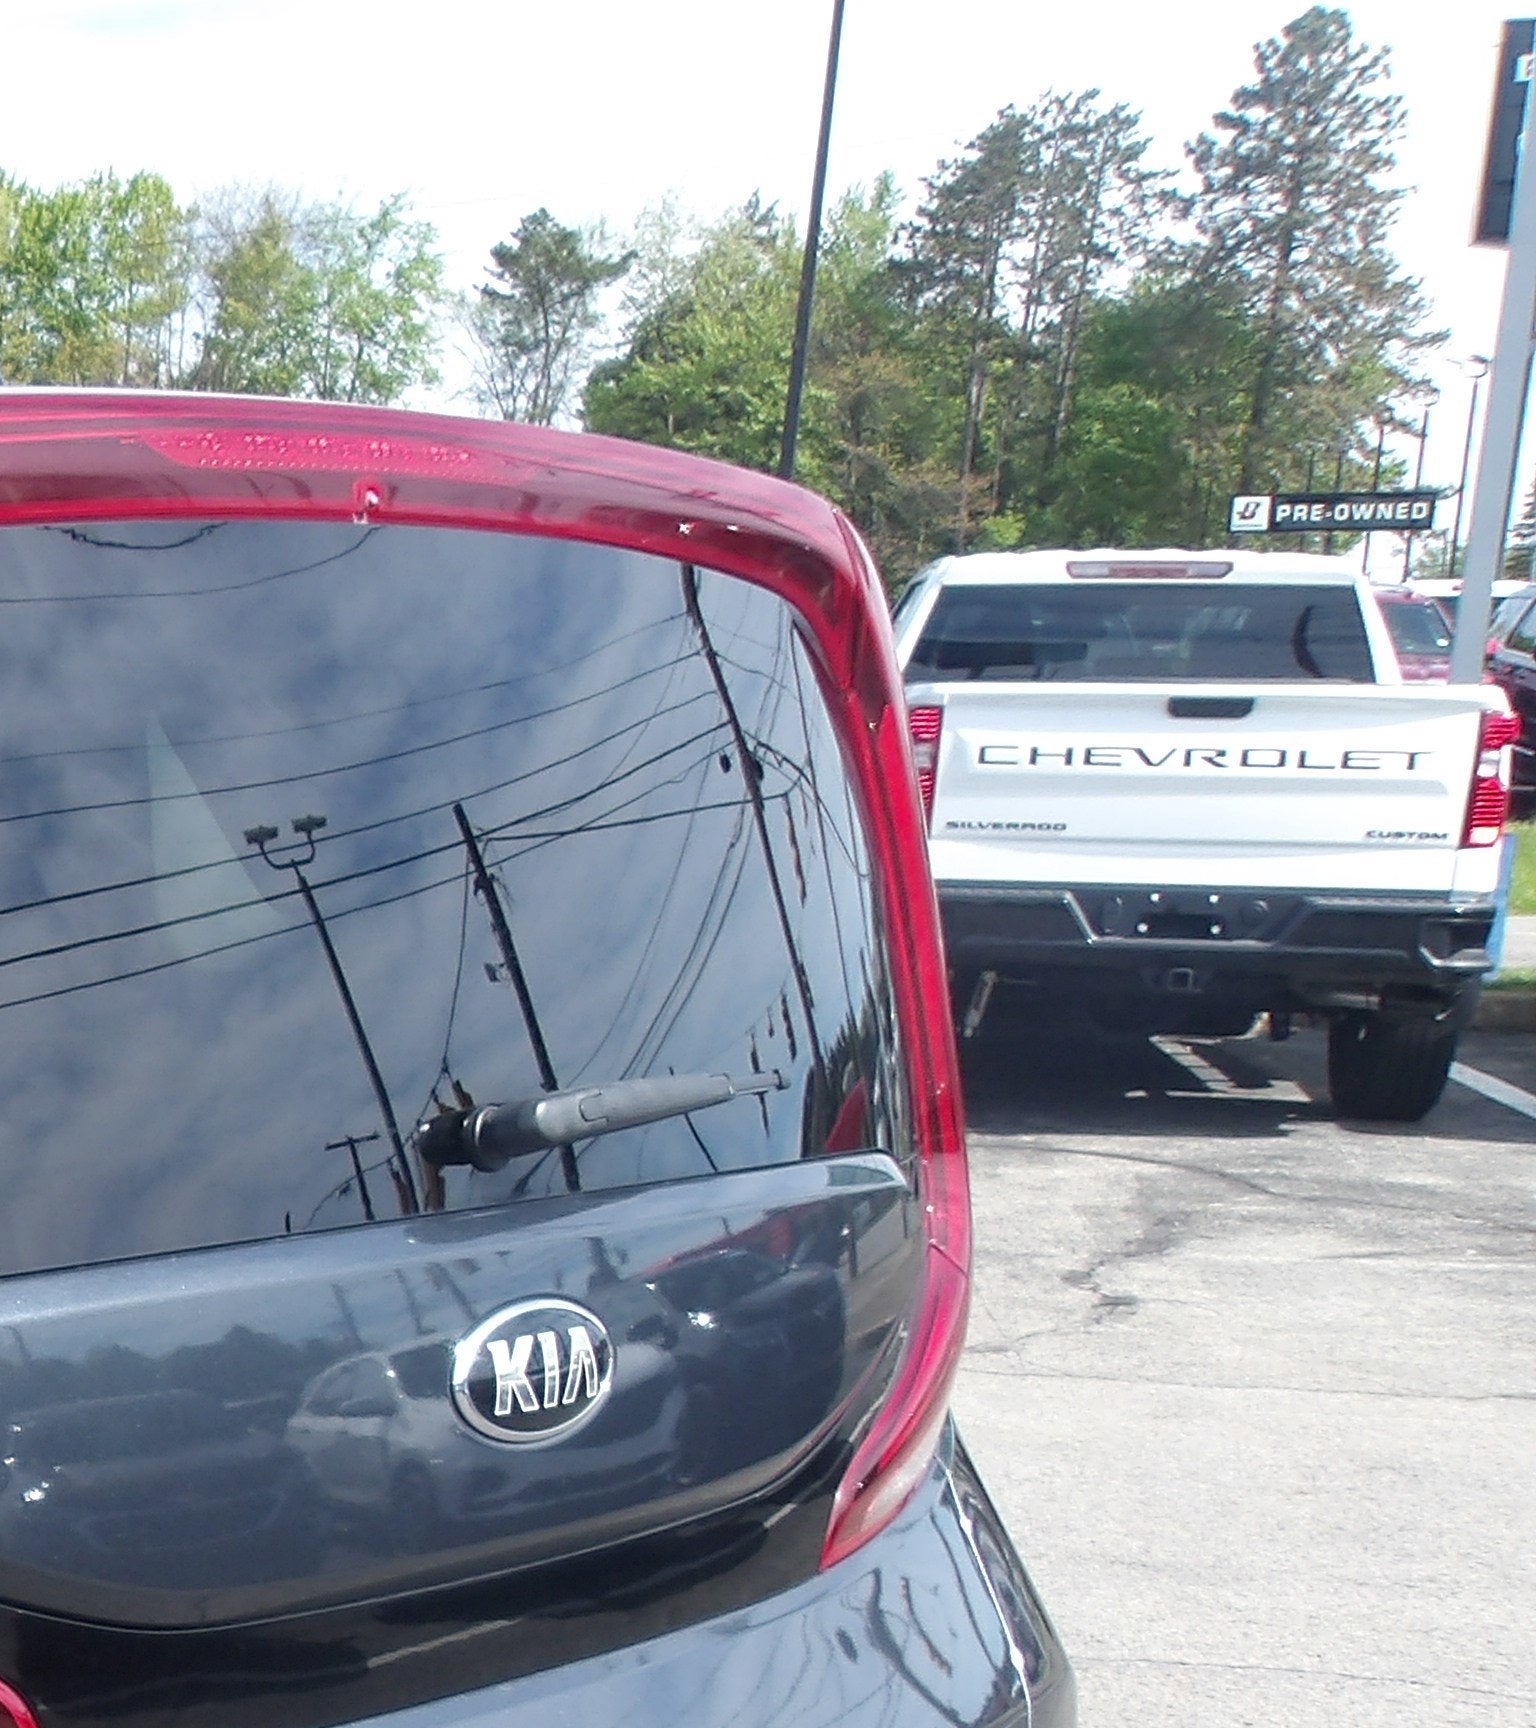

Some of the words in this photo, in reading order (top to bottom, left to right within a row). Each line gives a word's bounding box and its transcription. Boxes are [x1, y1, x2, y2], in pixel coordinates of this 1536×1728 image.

[1275, 502, 1428, 522] PRE-OWNED
[977, 745, 1436, 771] CHEVROLET
[944, 820, 1068, 832] SILVERADO
[1364, 829, 1449, 841] CUSTOM
[486, 1325, 601, 1417] KIA
